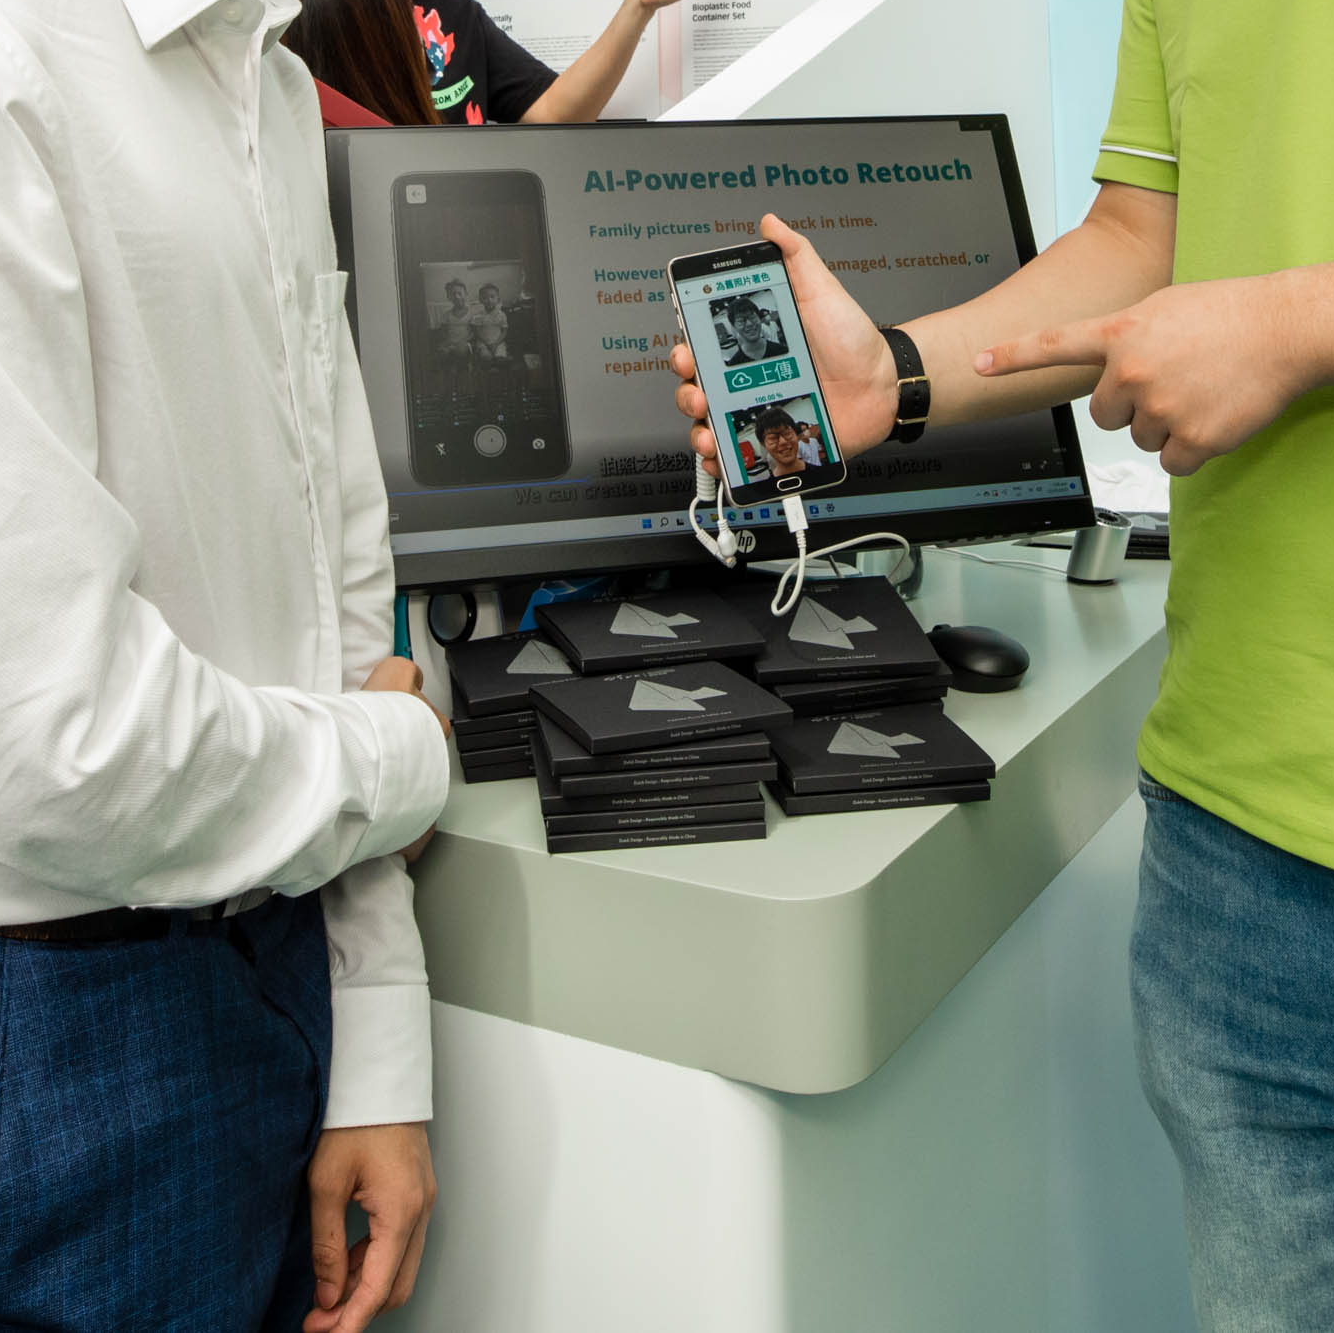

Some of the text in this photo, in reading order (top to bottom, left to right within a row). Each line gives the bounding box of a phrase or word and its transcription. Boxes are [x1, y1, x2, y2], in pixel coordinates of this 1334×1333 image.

[692, 0, 752, 12] Bioplastic Food
[692, 12, 745, 22] Container Set
[583, 159, 972, 193] AI-Powered Photo Retouch
[589, 222, 642, 240] Family
[647, 221, 711, 239] pictures
[714, 219, 756, 235] bring
[821, 216, 835, 229] in
[839, 214, 877, 228] time.
[712, 258, 742, 270] SAMSUNG
[895, 251, 971, 269] scratched,
[975, 252, 990, 263] or
[597, 290, 665, 305] faded as
[602, 335, 649, 352] Using
[652, 334, 667, 347] AI
[605, 357, 671, 377] repairin
[758, 360, 794, 385] 上傳
[547, 489, 578, 503] can
[585, 485, 637, 500] create
[658, 478, 693, 494] new
[737, 529, 754, 553] hp
